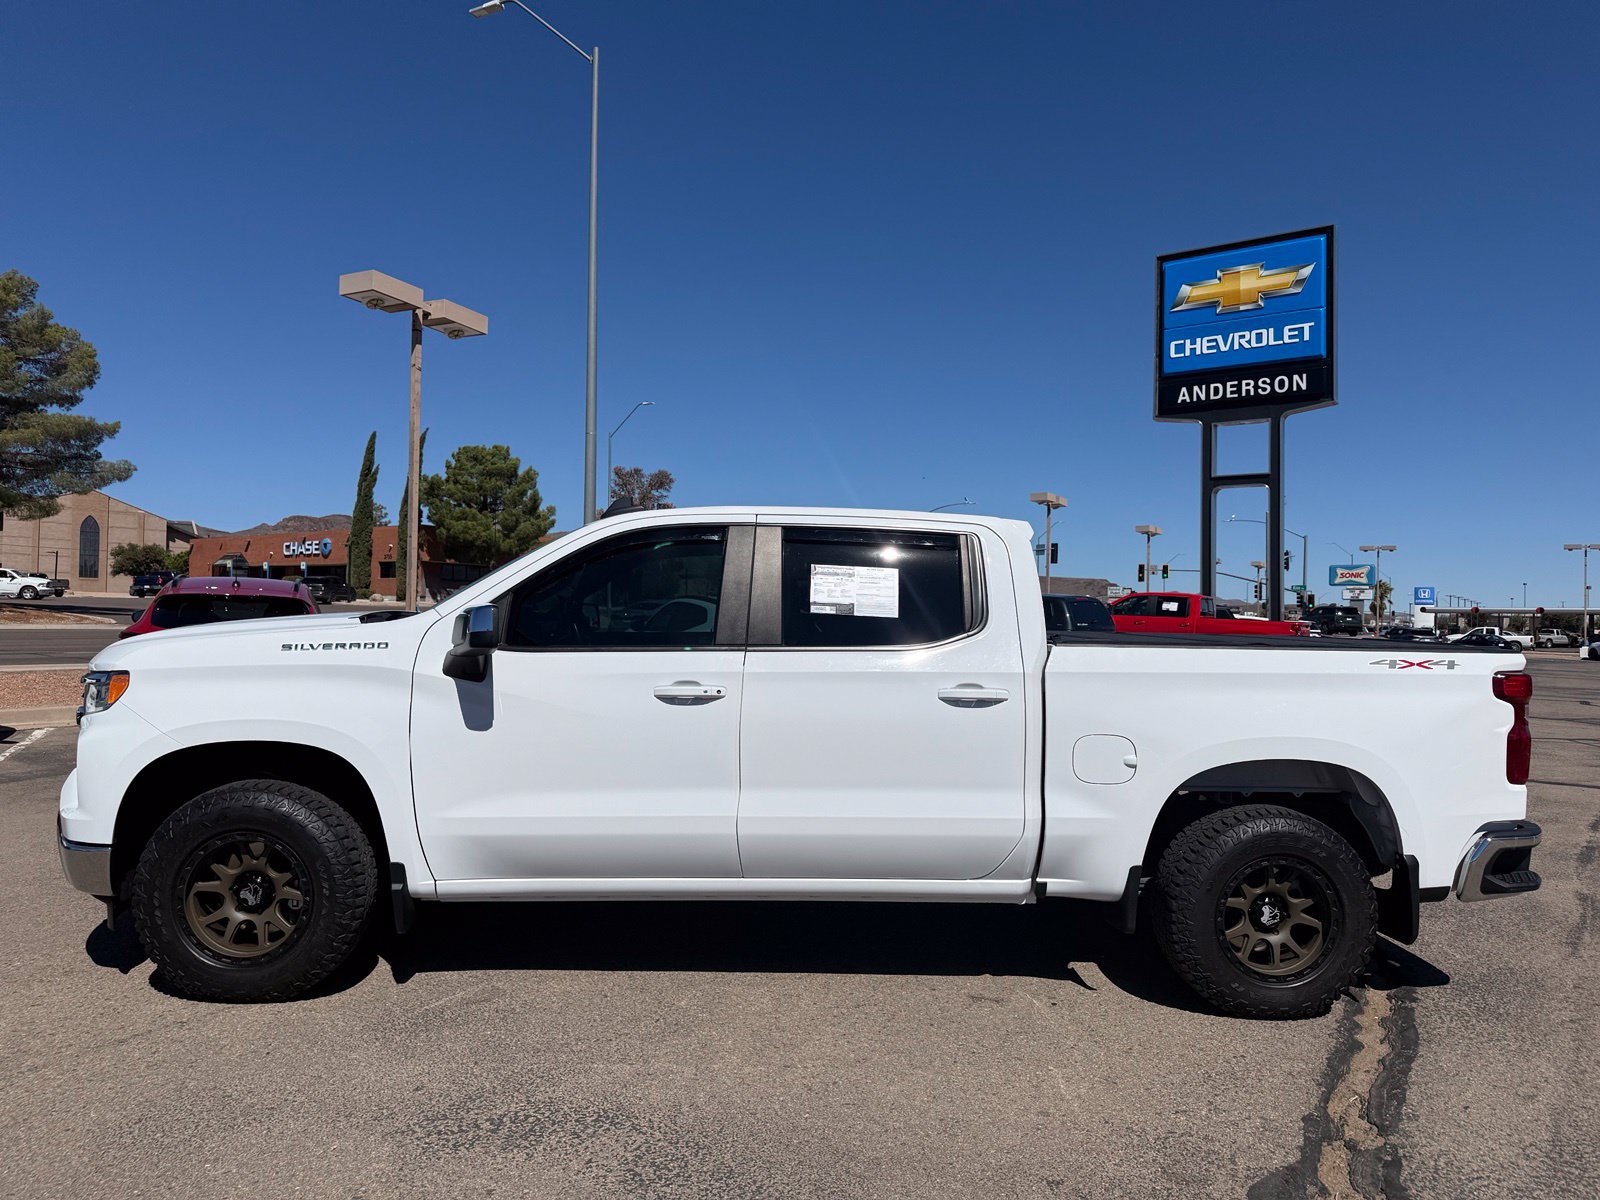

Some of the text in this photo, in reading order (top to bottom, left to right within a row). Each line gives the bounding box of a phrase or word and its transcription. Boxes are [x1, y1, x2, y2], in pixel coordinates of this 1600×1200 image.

[1169, 322, 1315, 359] CHEVROLET
[1177, 373, 1308, 404] ANDERSON
[283, 540, 321, 556] CHASE
[280, 641, 390, 652] SILVERADO
